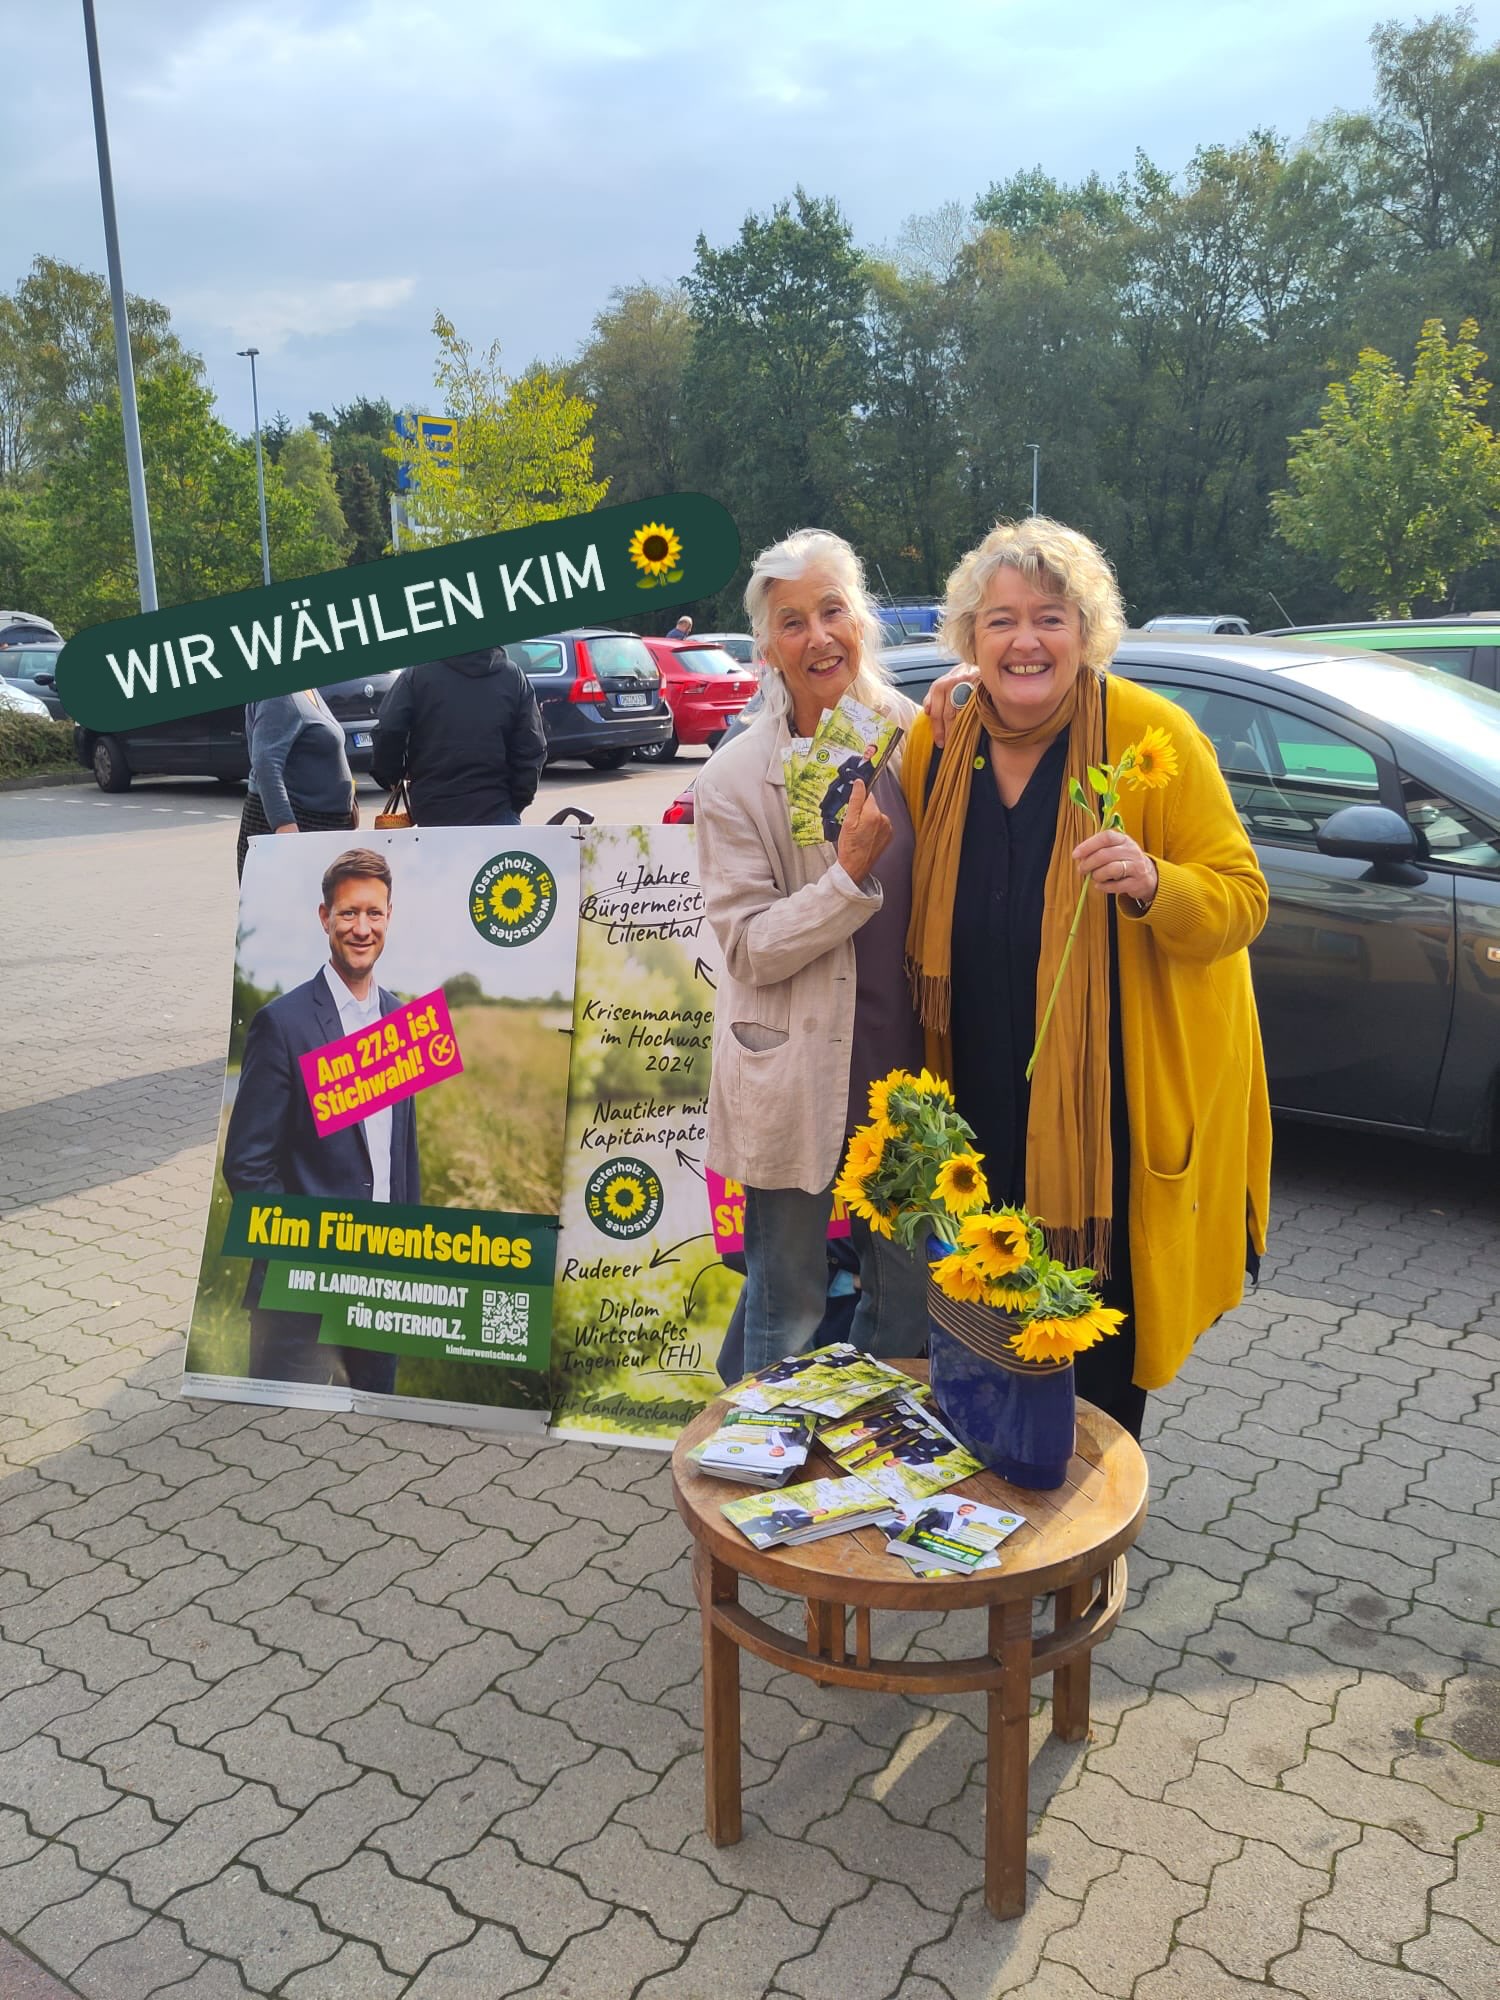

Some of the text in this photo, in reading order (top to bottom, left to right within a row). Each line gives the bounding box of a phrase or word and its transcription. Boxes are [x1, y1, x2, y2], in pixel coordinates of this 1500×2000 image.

[475, 857, 537, 894] Osterholz:
[616, 864, 690, 894] 4 Jahre
[473, 897, 487, 923] Für
[583, 891, 706, 922] Bürgermeist
[607, 918, 702, 945] Lilienthal
[582, 999, 715, 1029] Krisenmanage
[317, 1005, 440, 1087] Am 27.9. ist
[600, 1025, 713, 1049] im Hochwas
[645, 1055, 695, 1074] 2024
[313, 1045, 426, 1121] Stichwahl!
[593, 1096, 709, 1124] Nautiker mit
[580, 1123, 708, 1153] Kapitänspate
[590, 1162, 646, 1193] Osterholz:
[589, 1195, 602, 1217] Für
[248, 1206, 532, 1269] Kim Fürwentsches
[562, 1258, 643, 1282] Ruderer
[288, 1269, 469, 1308] IHR LANDRATSKANDIDAT
[347, 1302, 466, 1340] FÜR OSTERHOLZ.
[599, 1297, 660, 1325] Diplom
[575, 1321, 687, 1347] Wirtschafts
[562, 1342, 702, 1376] Ingenieur (FH)
[552, 1394, 695, 1424] Ihr Landratskandi
